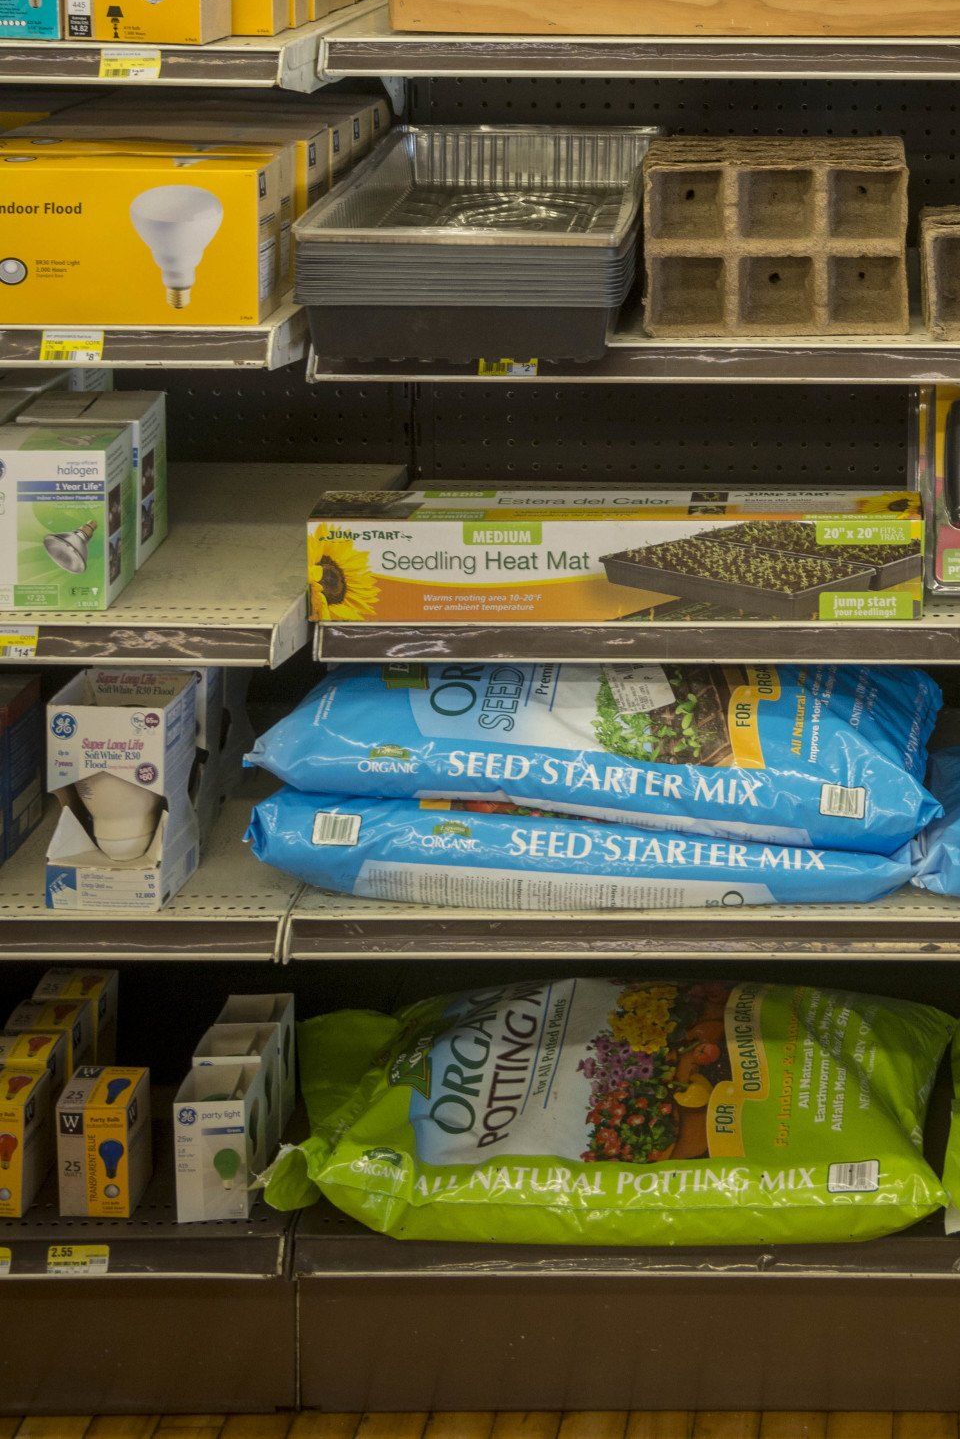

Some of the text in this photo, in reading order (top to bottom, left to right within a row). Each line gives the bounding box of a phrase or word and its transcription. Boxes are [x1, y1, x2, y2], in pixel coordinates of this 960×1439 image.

[57, 465, 98, 477] halogen
[326, 530, 401, 541] JUMP START
[473, 530, 531, 544] MEDIUM
[833, 596, 897, 609] jump start
[82, 738, 144, 752] Super Long Life
[448, 751, 762, 807] SEED STARTER MIX
[202, 1110, 241, 1121] party light
[64, 1160, 81, 1171] 25
[51, 1247, 73, 1257] 2.55
